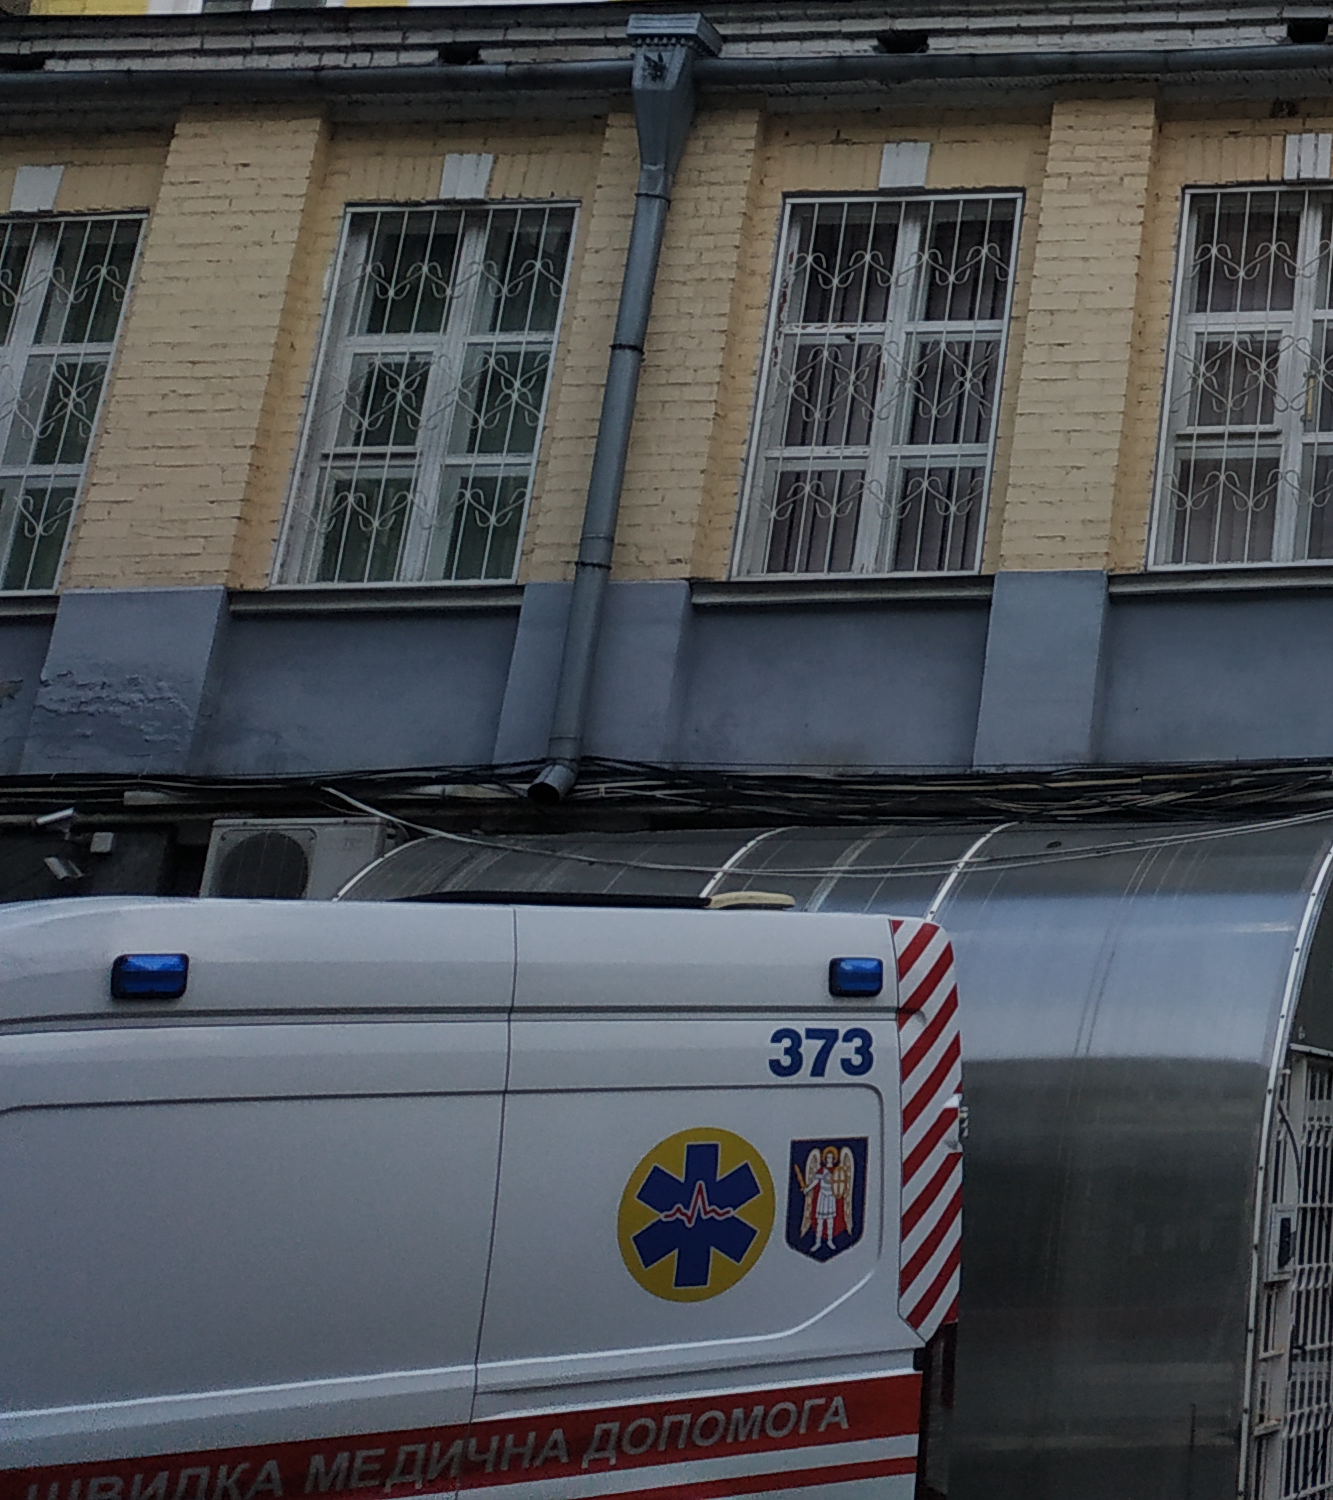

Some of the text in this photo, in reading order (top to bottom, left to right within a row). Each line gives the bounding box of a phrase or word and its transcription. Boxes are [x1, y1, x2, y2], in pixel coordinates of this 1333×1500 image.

[768, 1027, 874, 1078] 373
[304, 1428, 570, 1493] МЕДИЧНА
[581, 1396, 851, 1469] ДОПОМОГА
